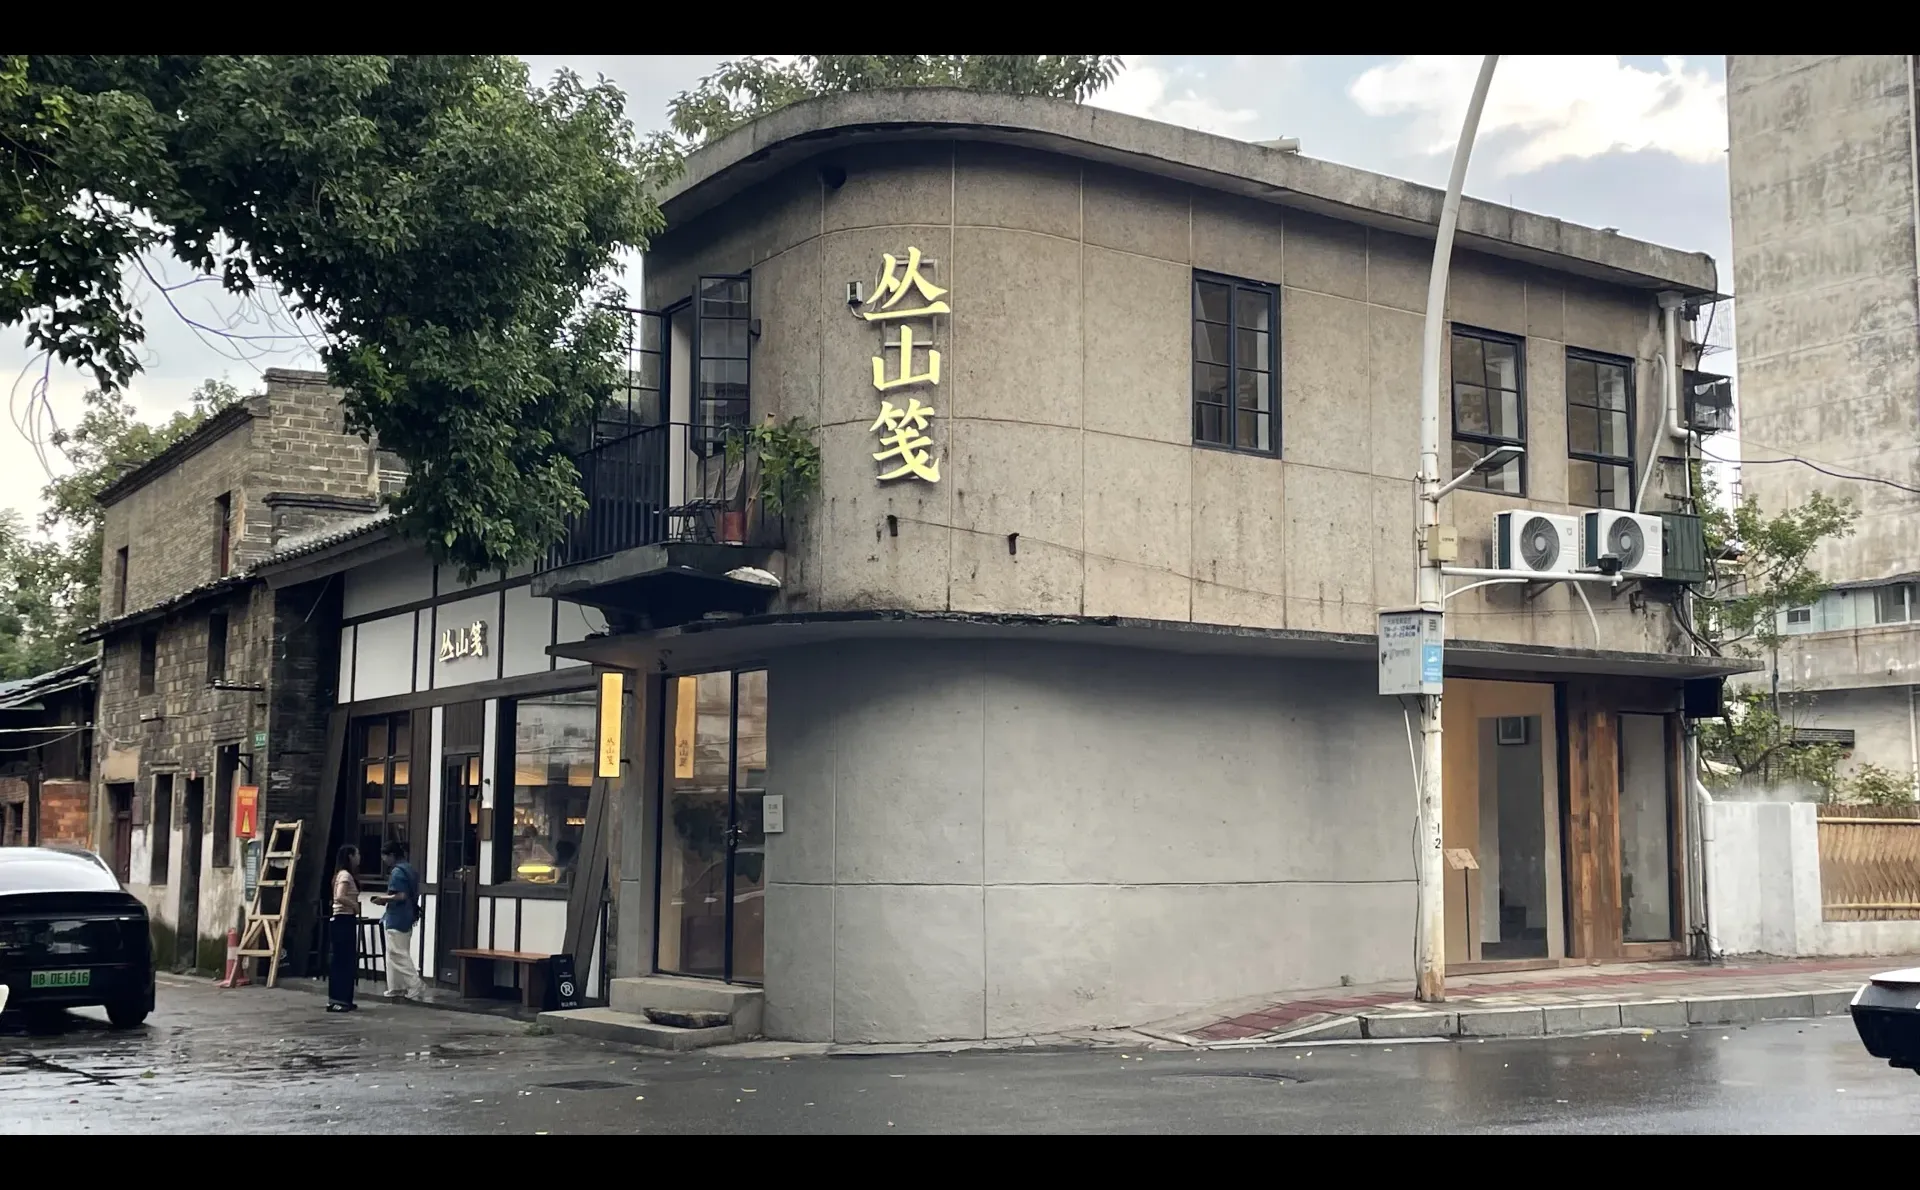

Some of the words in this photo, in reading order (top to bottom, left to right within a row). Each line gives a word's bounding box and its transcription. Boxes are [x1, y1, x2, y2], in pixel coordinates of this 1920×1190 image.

[863, 247, 950, 482] 丛山笺
[439, 620, 484, 662] 丛山笺
